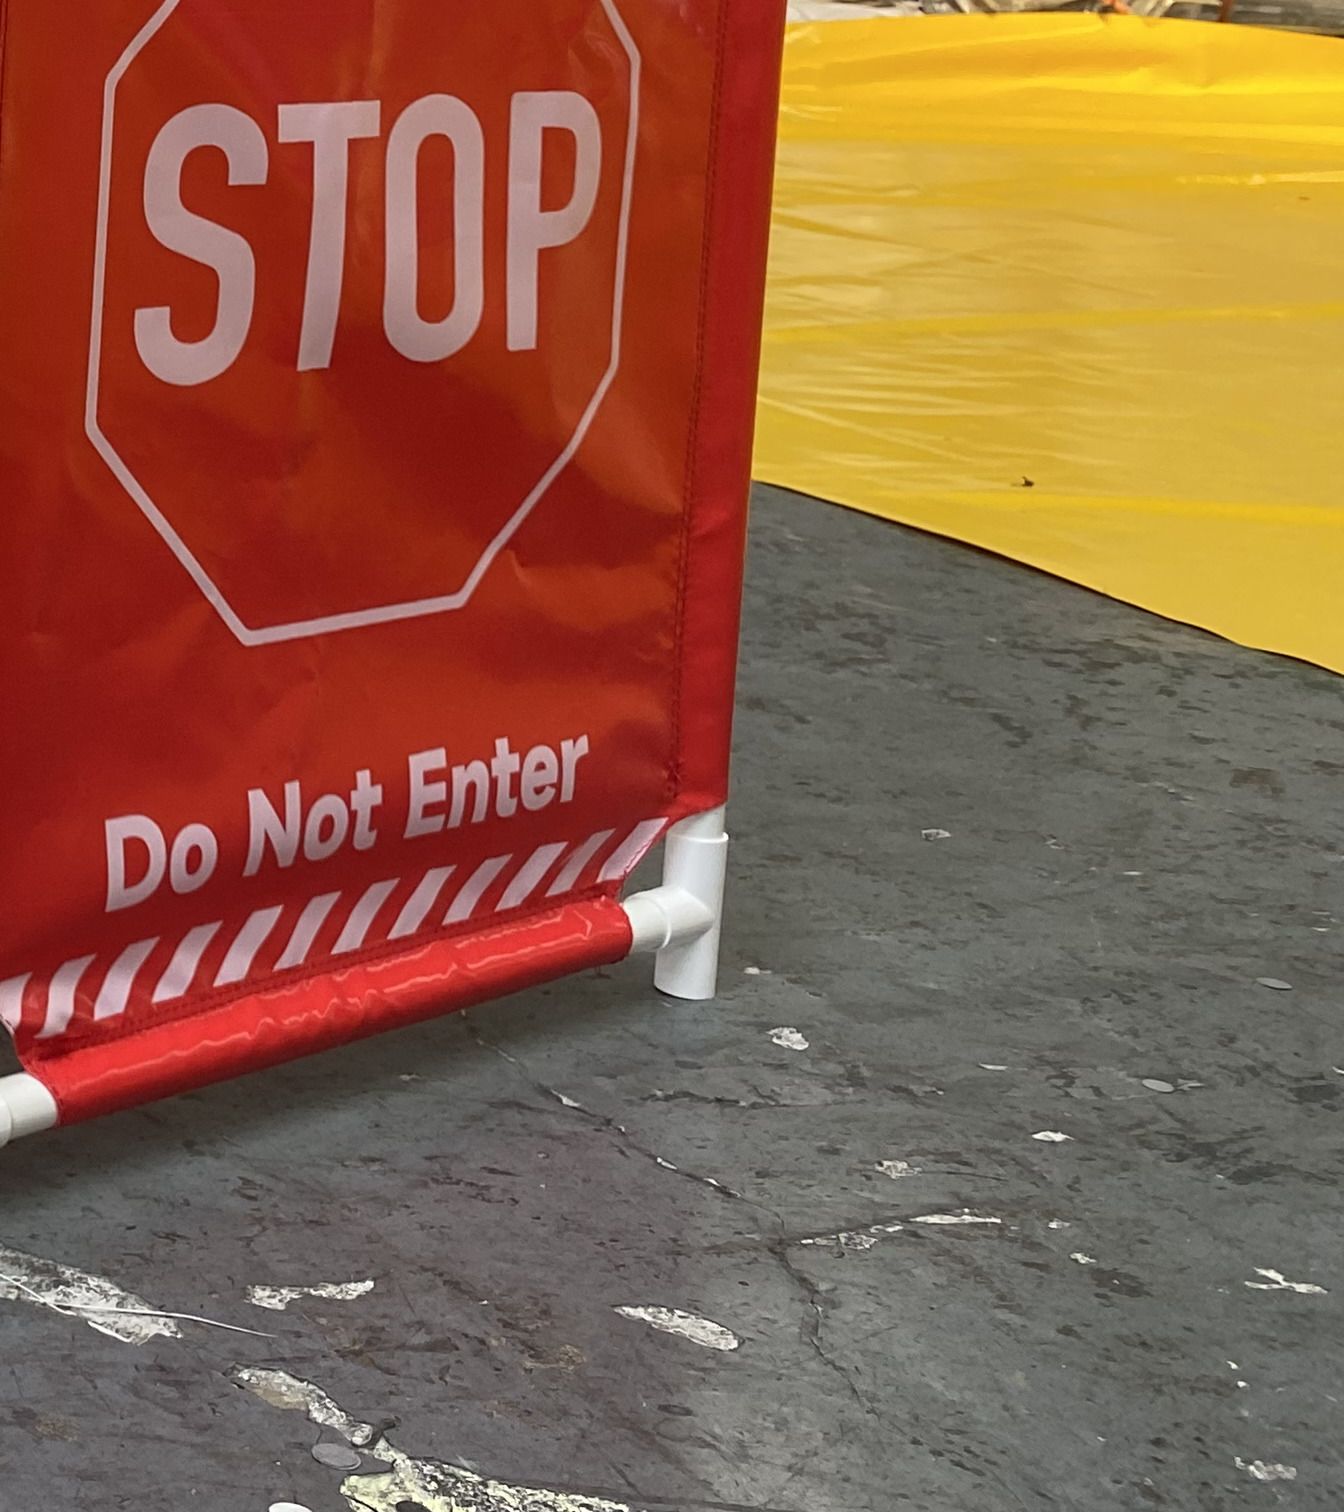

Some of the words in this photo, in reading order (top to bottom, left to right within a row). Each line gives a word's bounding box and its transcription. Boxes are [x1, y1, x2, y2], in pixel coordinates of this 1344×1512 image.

[132, 90, 603, 387] STOP
[104, 814, 218, 912] Do
[246, 769, 383, 876] Not
[402, 734, 590, 840] Enter
